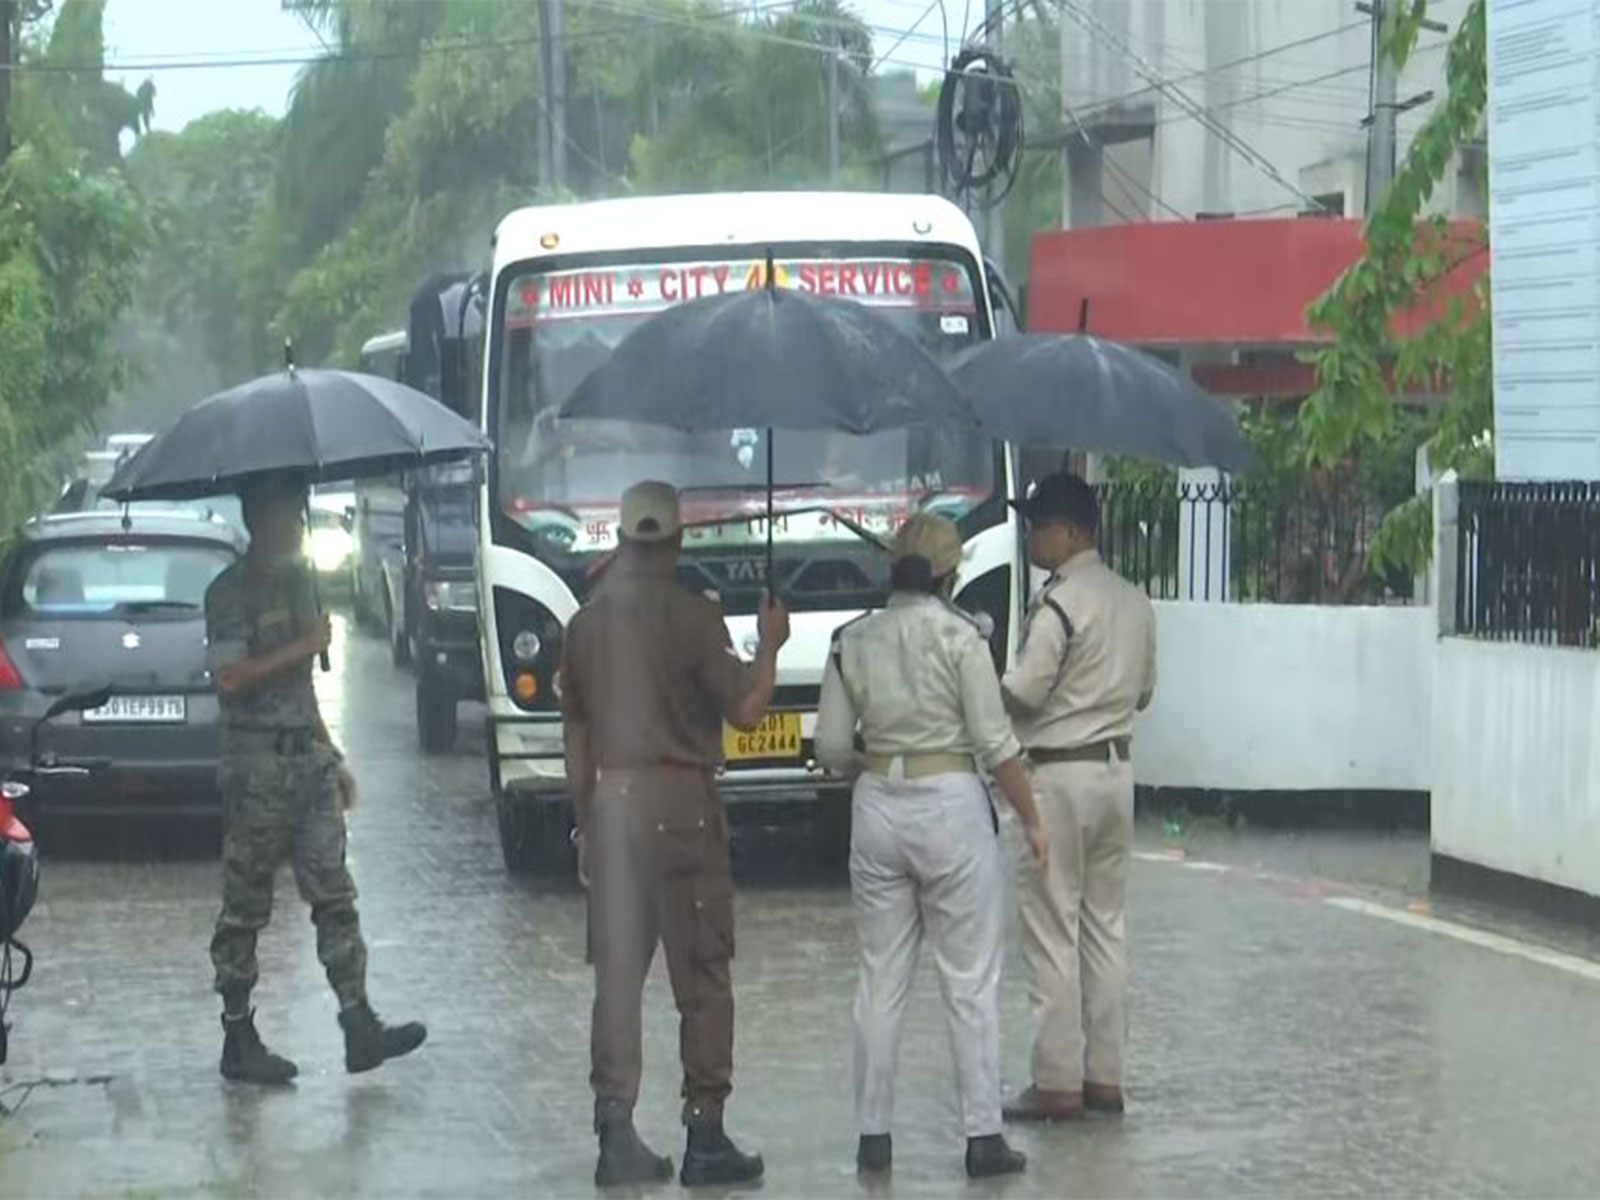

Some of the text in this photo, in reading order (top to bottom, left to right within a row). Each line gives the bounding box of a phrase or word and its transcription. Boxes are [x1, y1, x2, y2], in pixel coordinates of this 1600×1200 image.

[549, 271, 613, 307] MINI
[660, 262, 730, 300] CITY
[799, 260, 931, 295] SERVICE
